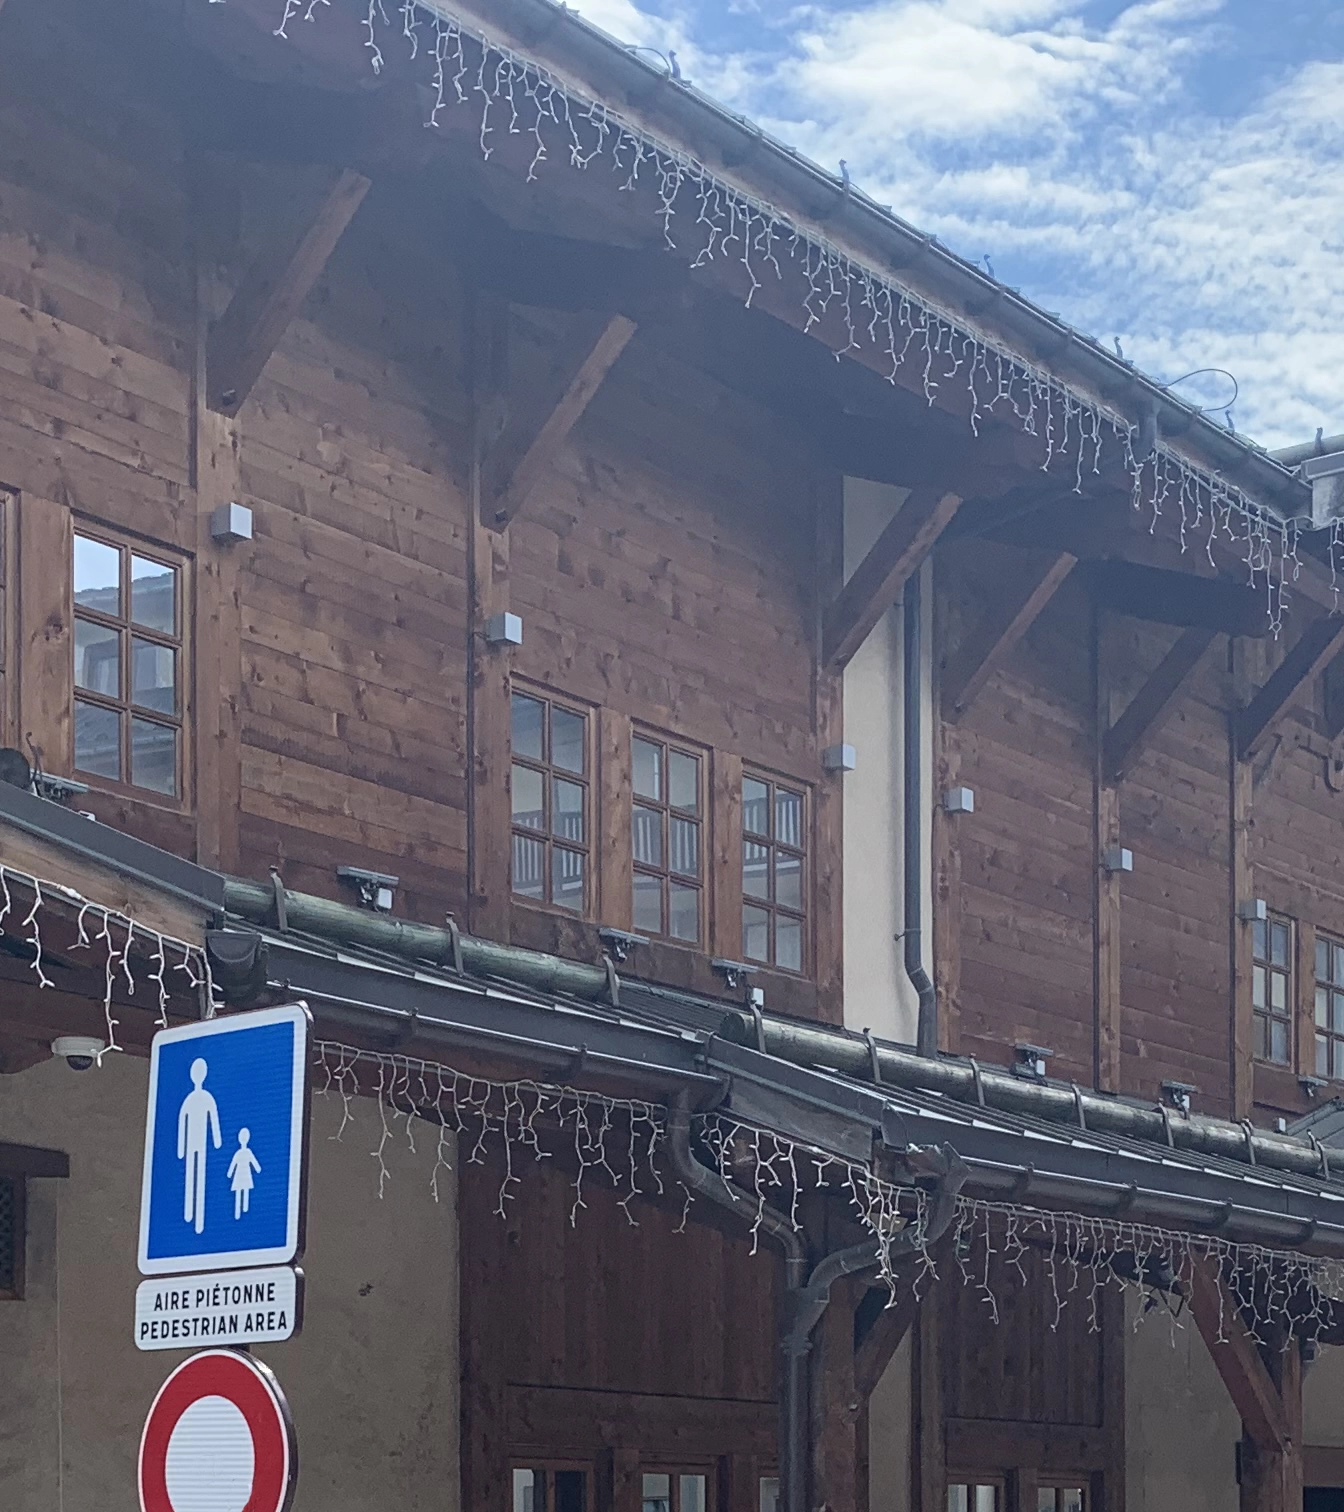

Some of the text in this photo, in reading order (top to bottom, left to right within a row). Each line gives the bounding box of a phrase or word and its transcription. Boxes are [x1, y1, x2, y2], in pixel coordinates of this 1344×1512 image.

[154, 1282, 276, 1312] AIRE PIÉTONNE
[140, 1310, 288, 1341] PEDESTRIAN AREA
